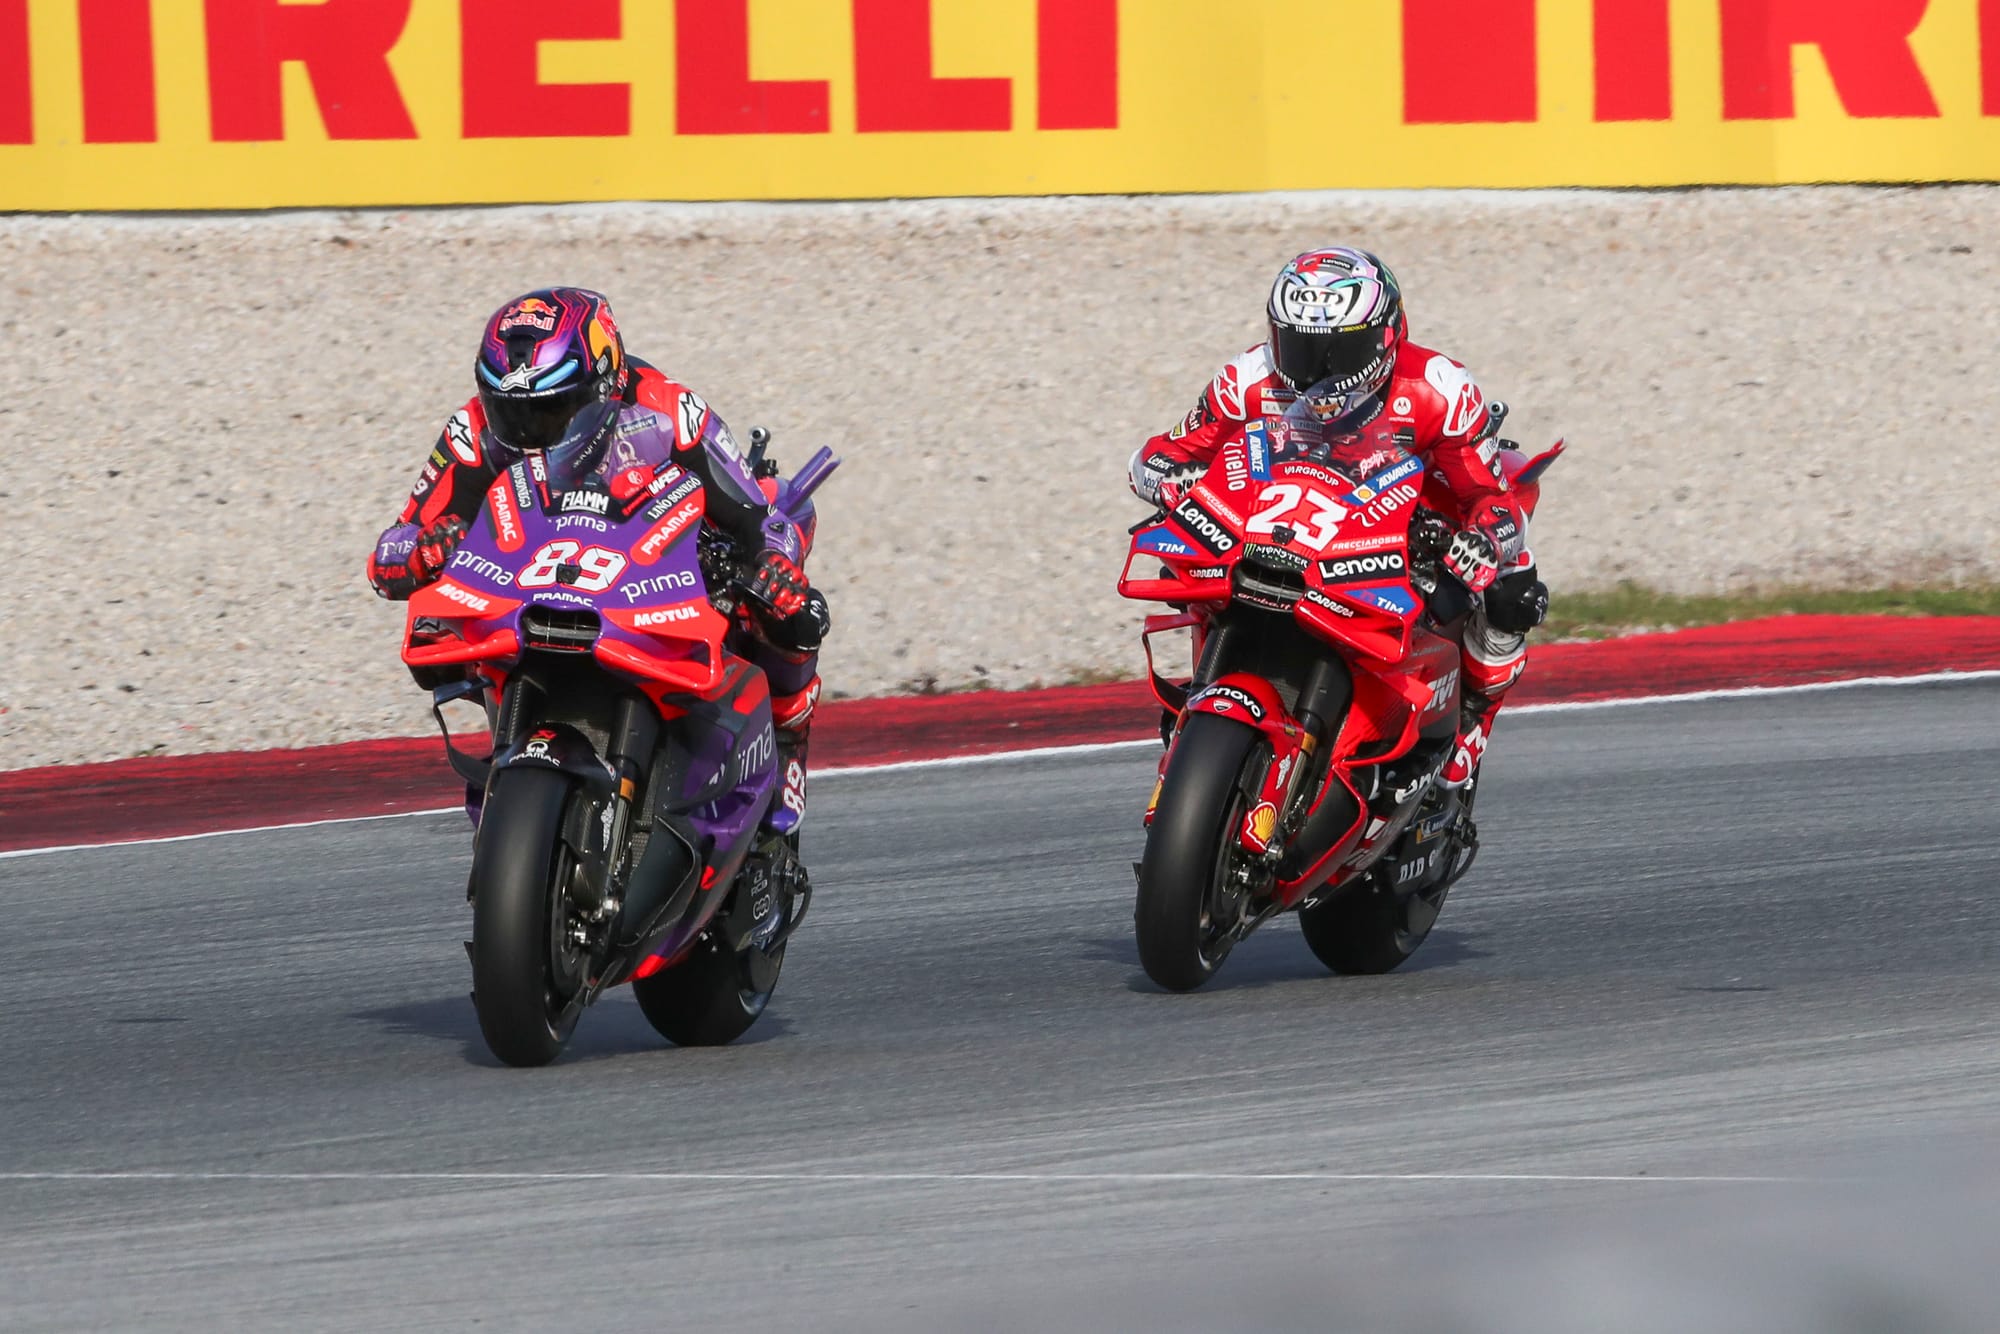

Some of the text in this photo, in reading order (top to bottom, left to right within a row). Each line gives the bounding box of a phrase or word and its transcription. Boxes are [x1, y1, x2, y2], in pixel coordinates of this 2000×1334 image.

[1295, 325, 1333, 335] TERRANOVA
[1334, 356, 1381, 392] TERRANOVA
[647, 466, 682, 495] WRS
[1284, 466, 1339, 487] VARGROUP
[1375, 458, 1418, 490] ADVANCE
[561, 490, 609, 512] FIAMM
[647, 497, 672, 519] LINO
[666, 475, 701, 504] SONEGO
[492, 485, 517, 542] PRAMAC
[555, 514, 607, 532] prima
[1175, 498, 1233, 551] Lenovo
[1245, 483, 1349, 552] 23
[640, 502, 699, 555] PRAMAC
[1157, 542, 1186, 554] TIM
[1332, 535, 1404, 550] FRECCIAROSSA
[450, 550, 514, 585] prima
[515, 538, 629, 593] 89
[1255, 546, 1308, 568] MONSTER
[1318, 554, 1404, 579] Lenovo
[1189, 568, 1224, 578] CARRERA
[435, 583, 490, 611] MOTUL
[620, 570, 696, 603] prima
[533, 592, 593, 607] PRAMAC
[1238, 592, 1292, 611] aruba.it
[1307, 590, 1355, 618] CARRERA
[1376, 597, 1405, 614] TIM
[633, 606, 700, 627] MOTUL
[509, 752, 561, 767] PRAMAC
